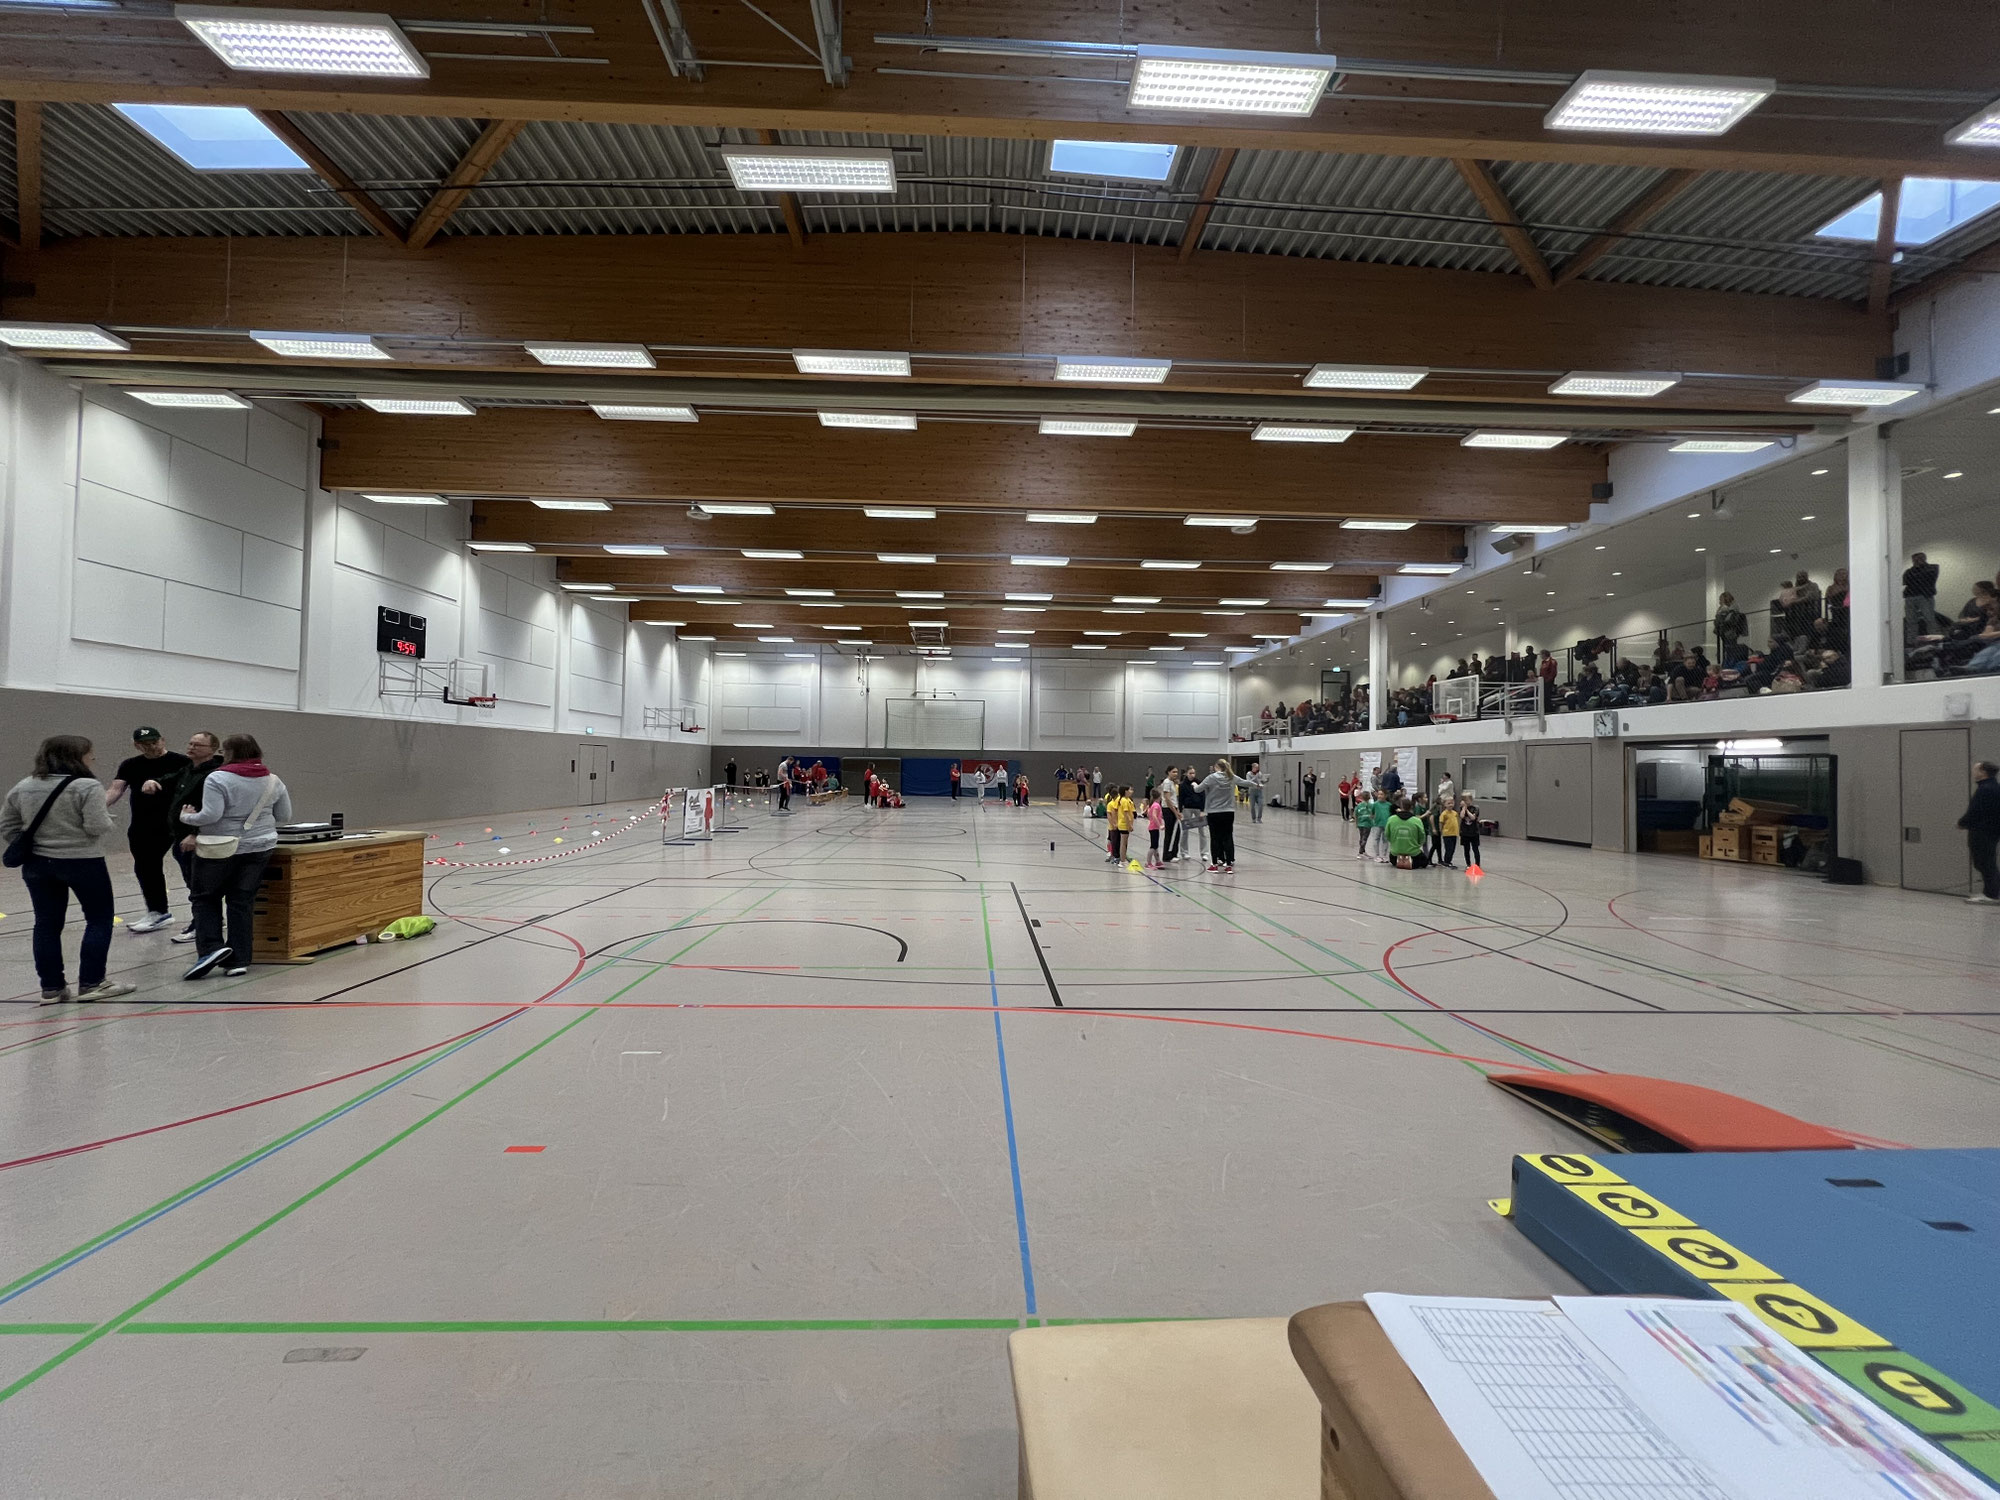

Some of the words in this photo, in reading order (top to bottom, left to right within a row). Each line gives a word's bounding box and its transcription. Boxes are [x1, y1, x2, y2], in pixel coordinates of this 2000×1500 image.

[397, 642, 415, 654] 9:54
[1551, 1157, 1585, 1174] 1
[1606, 1198, 1651, 1216] 2
[1679, 1242, 1728, 1266] 3
[1766, 1299, 1822, 1329] 4
[1878, 1370, 1953, 1409] 5
